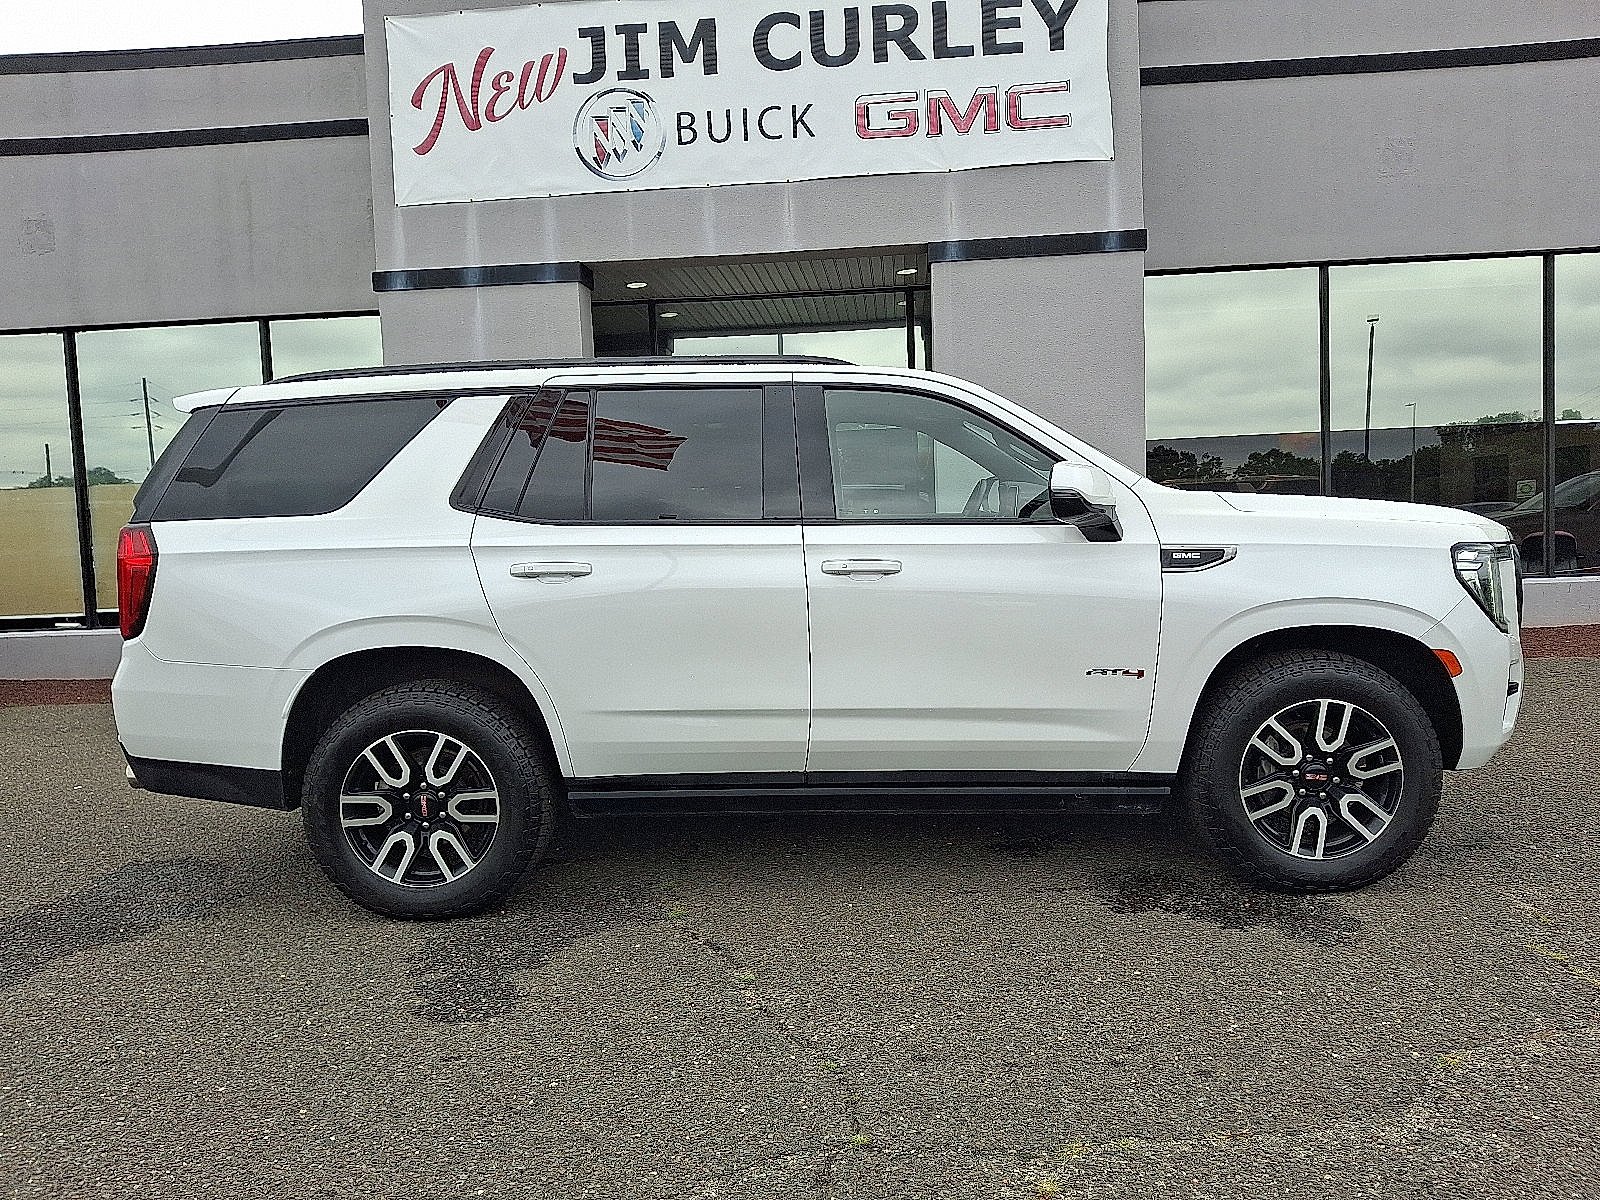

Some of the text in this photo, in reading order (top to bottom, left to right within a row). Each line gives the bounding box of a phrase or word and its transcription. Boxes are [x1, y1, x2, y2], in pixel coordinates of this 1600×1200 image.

[573, 18, 718, 84] JIM
[753, 0, 1079, 71] CURLEY
[676, 80, 1072, 146] BUICK GMC
